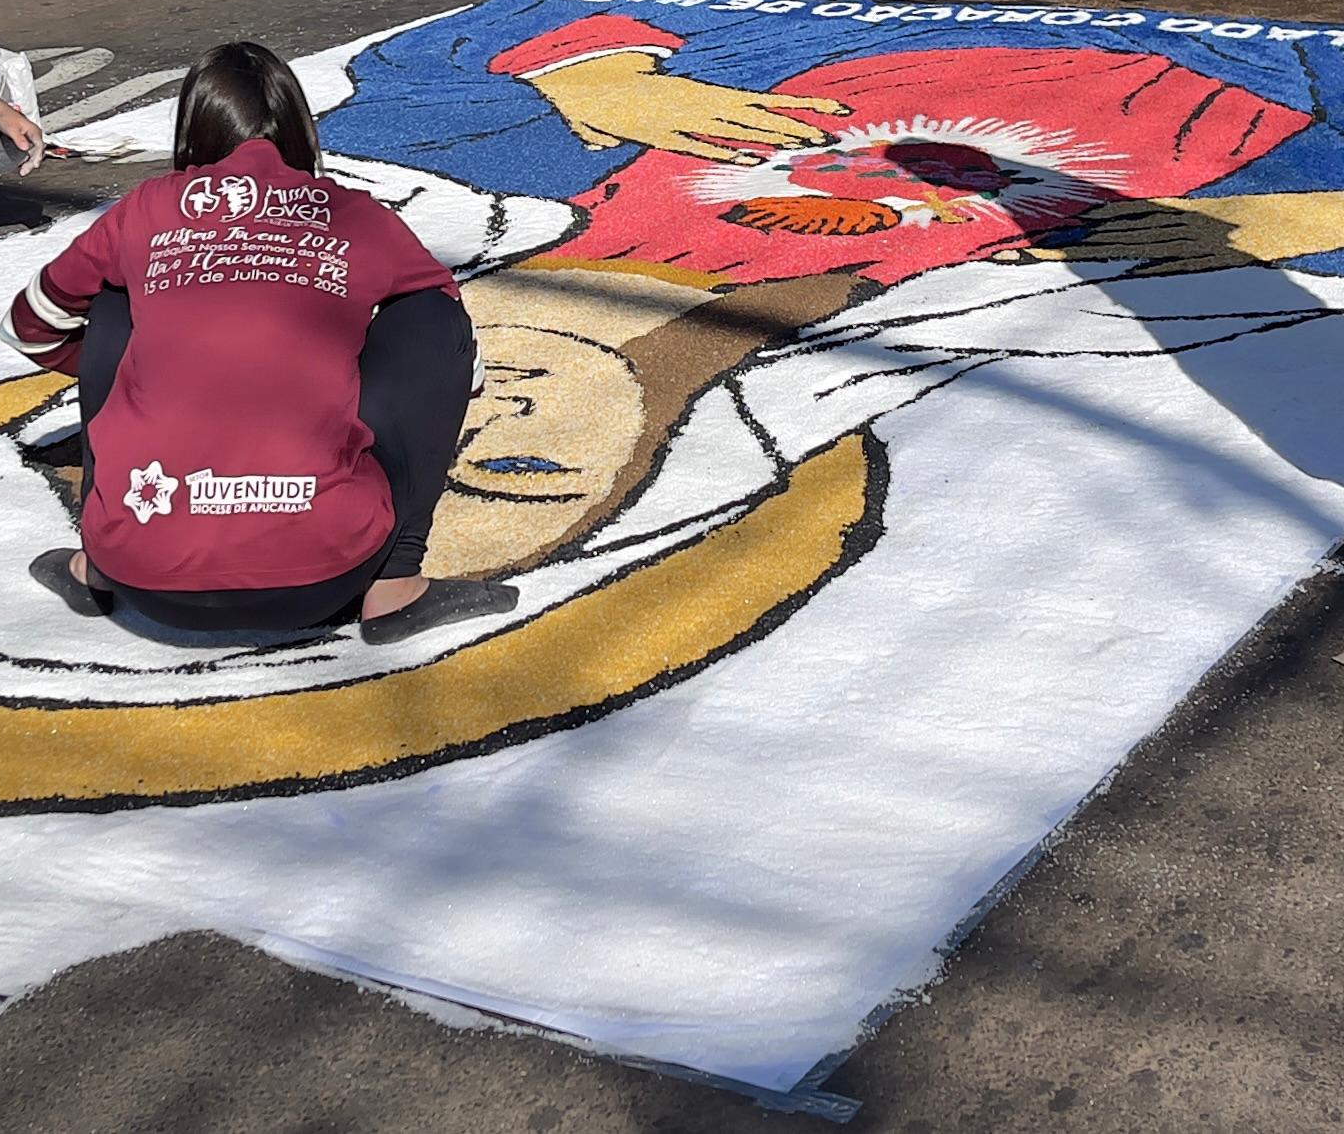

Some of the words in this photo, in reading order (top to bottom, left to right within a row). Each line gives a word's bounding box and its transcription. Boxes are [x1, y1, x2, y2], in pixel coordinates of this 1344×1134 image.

[810, 2, 1147, 27] CORAÇÃO
[264, 184, 330, 205] MISSÃO
[255, 203, 331, 223] JOVEM
[298, 231, 350, 256] 2022
[149, 244, 196, 262] Paróquia
[198, 243, 238, 252] Nossa
[241, 242, 295, 255] Senhora
[297, 248, 316, 258] da
[317, 250, 348, 269] Glória
[144, 281, 157, 296] 15
[158, 279, 170, 290] a
[176, 272, 195, 286] 17
[198, 270, 225, 283] de
[229, 268, 280, 281] Julho
[284, 272, 309, 286] de
[313, 277, 348, 299] 2022
[318, 262, 348, 284] PR
[193, 480, 313, 500] JUVENTUDE
[190, 504, 231, 515] DIOCESE
[234, 502, 247, 514] DE
[249, 500, 313, 514] APUCARANA
